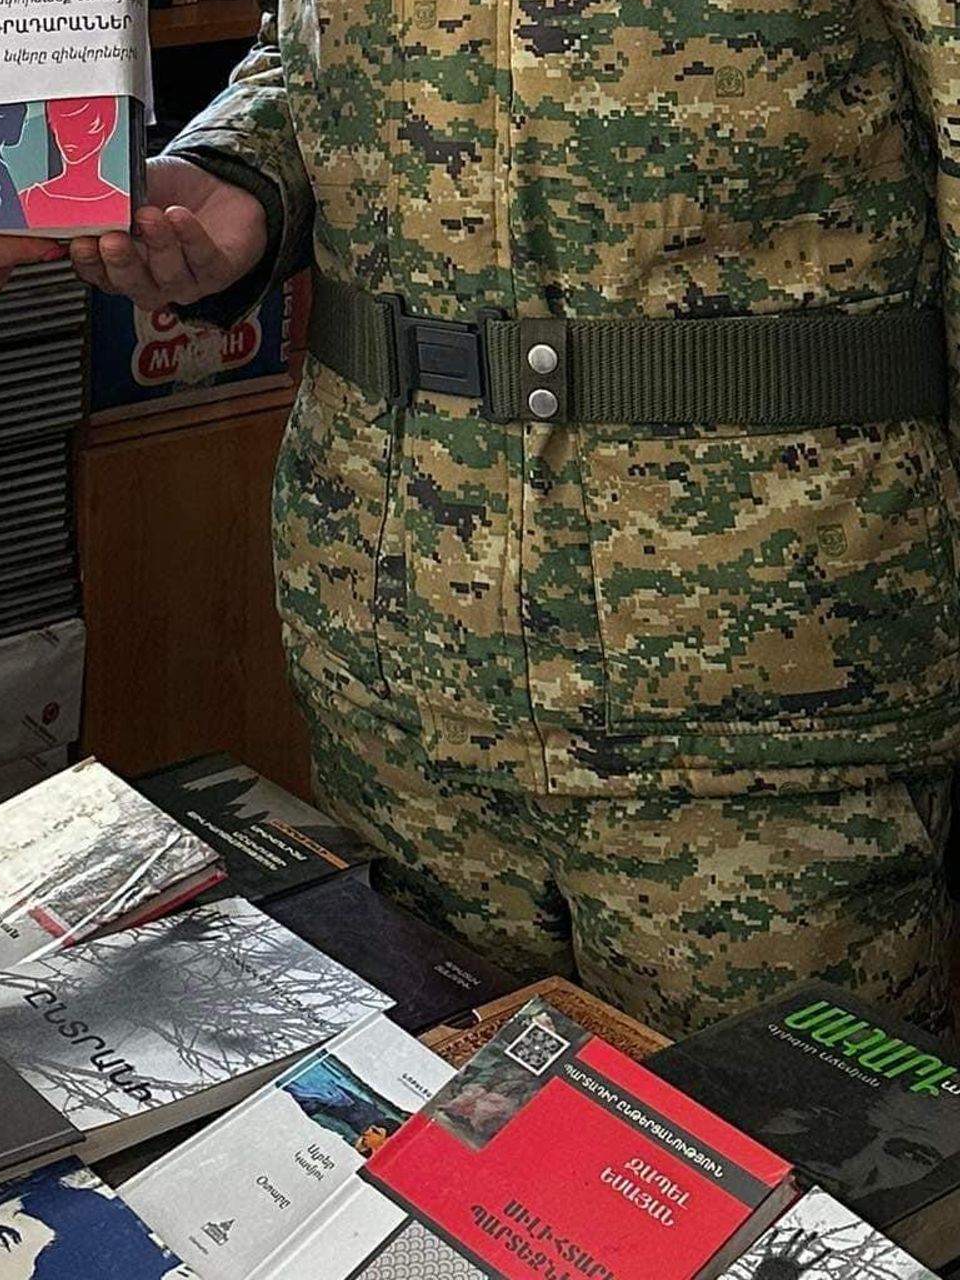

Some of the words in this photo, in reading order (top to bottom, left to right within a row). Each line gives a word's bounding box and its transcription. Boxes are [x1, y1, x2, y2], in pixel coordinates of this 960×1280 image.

[3, 47, 48, 65] նվերը
[23, 988, 153, 1103] ԸՆՏՐԱՆԻ
[563, 1063, 620, 1105] ՊԱՐՏԱԴԻՐ
[615, 1099, 725, 1178] ԸՆԹԵՐՑԱՆՈՒԹՅՈՒՆ
[293, 1150, 326, 1182] Կամյու
[306, 1143, 335, 1170] Ալբեր
[255, 1174, 291, 1210] Օտարը
[599, 1166, 677, 1228] ԵՍԱՅԱՆ
[623, 1157, 692, 1210] ԶԱՊԵԼ
